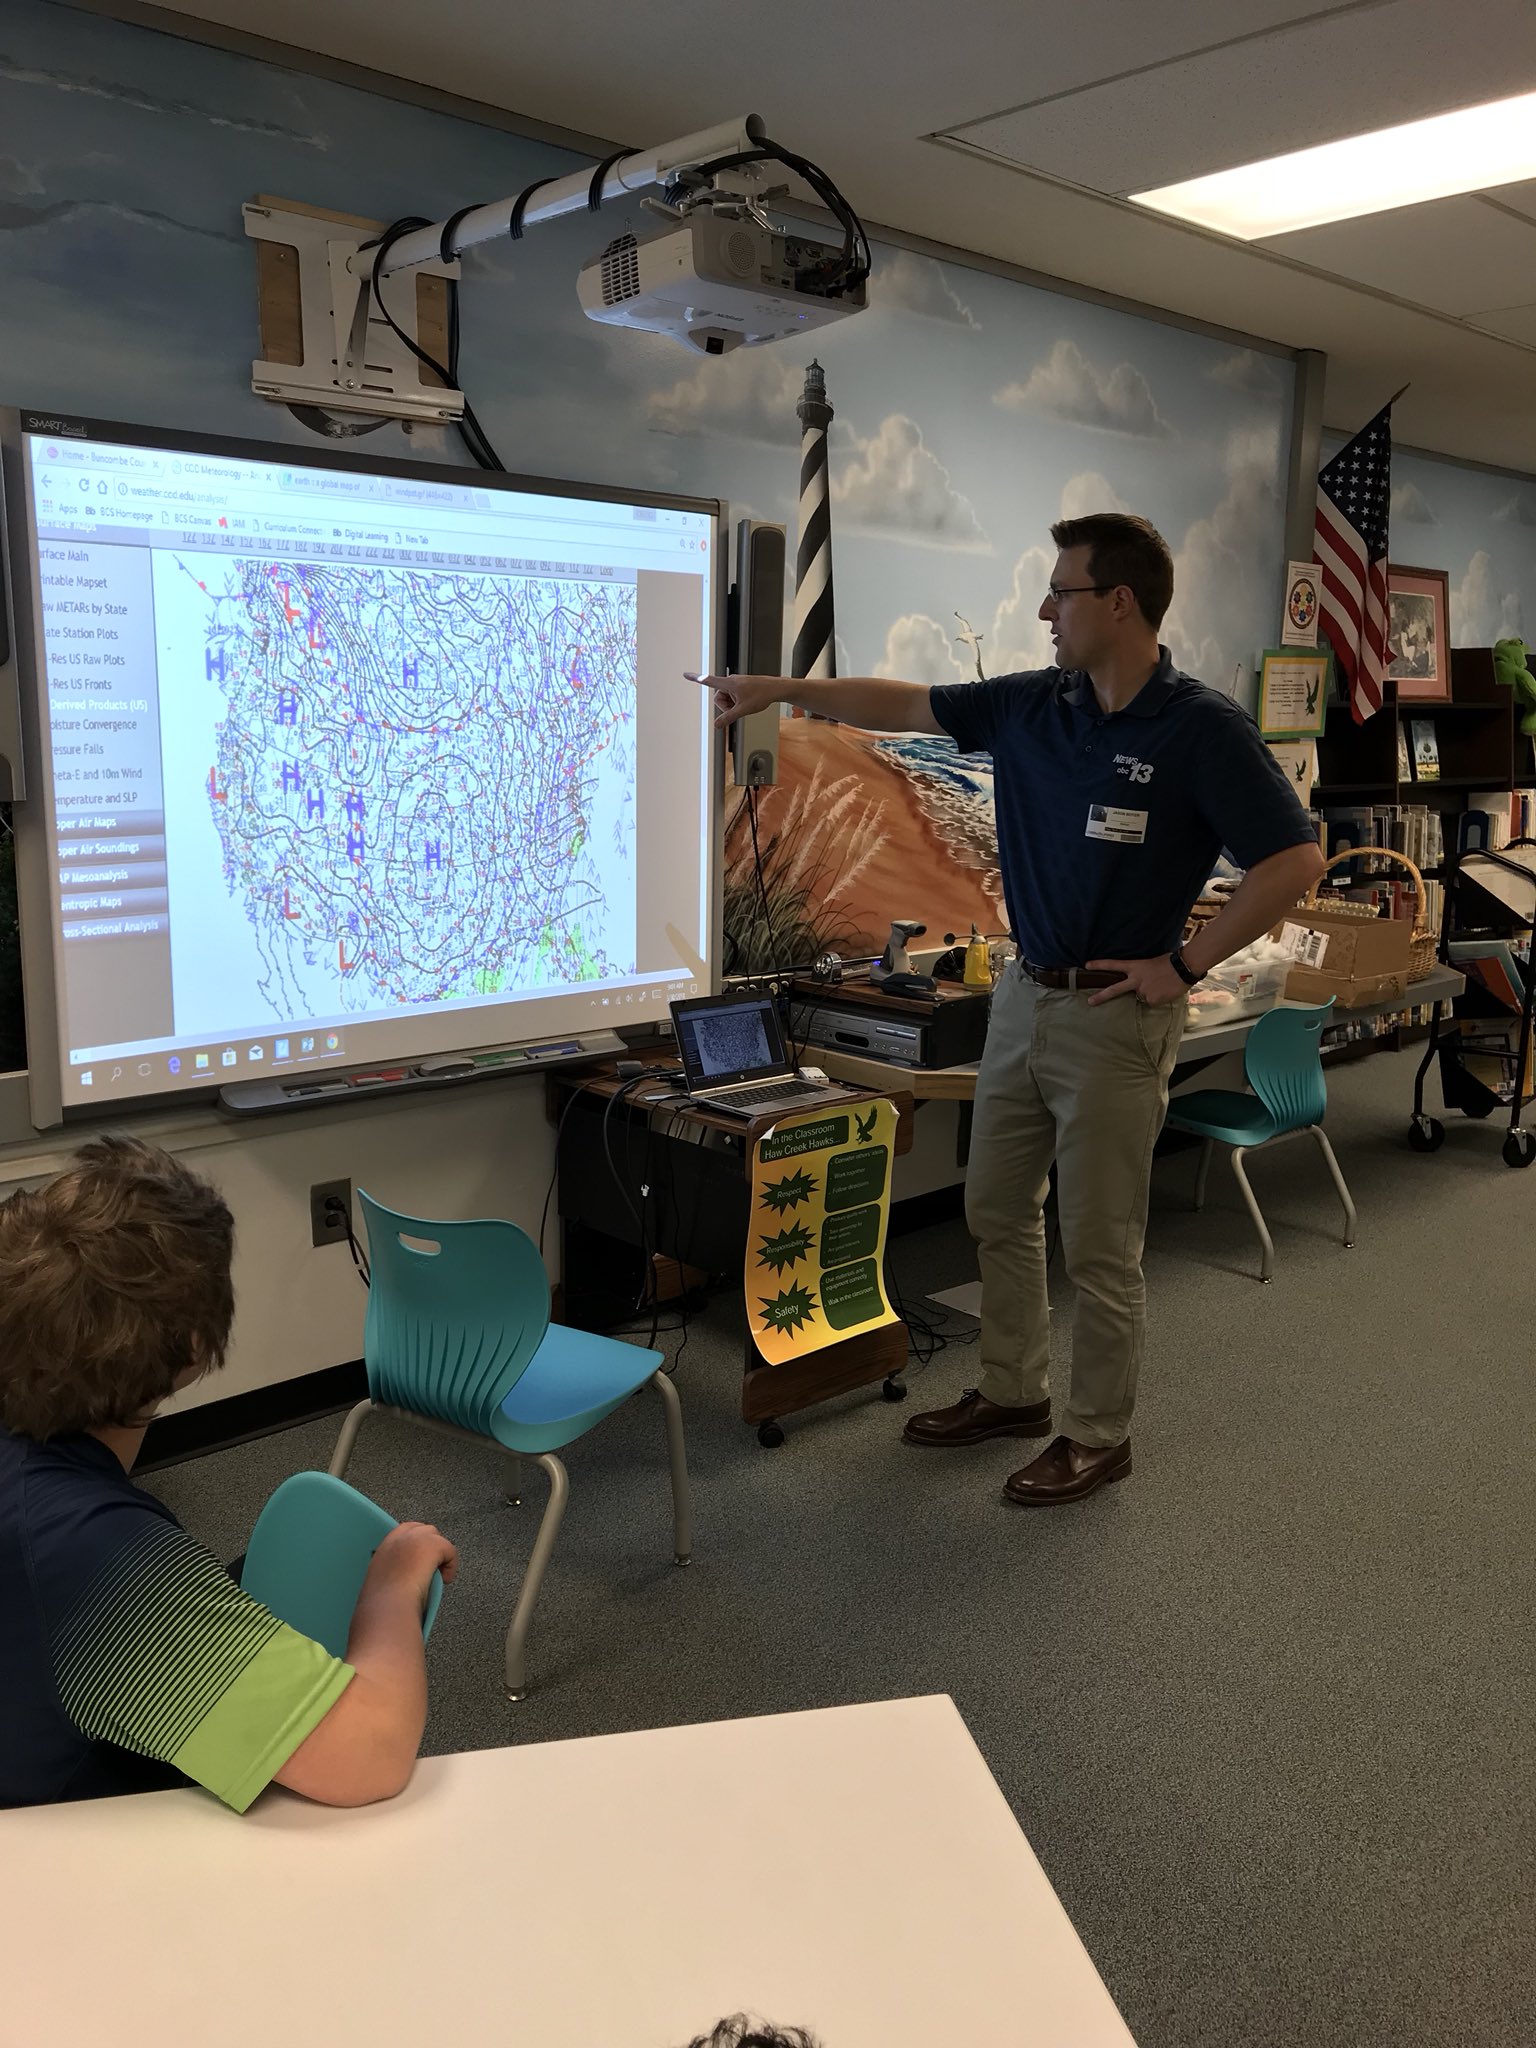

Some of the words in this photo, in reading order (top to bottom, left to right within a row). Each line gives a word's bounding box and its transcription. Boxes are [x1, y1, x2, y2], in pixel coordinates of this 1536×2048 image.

[29, 417, 62, 431] SMART
[62, 449, 84, 461] Home
[91, 451, 128, 466] Buncombe
[201, 465, 241, 480] Meteorology
[59, 503, 78, 515] Apps
[116, 508, 154, 522] Homepage
[345, 528, 363, 541] Digital
[365, 532, 389, 543] Learning
[405, 534, 418, 543] New
[419, 535, 429, 544] Tab
[67, 550, 89, 561] Main
[76, 576, 108, 590] Mapset
[56, 601, 90, 613] METARs
[91, 603, 102, 616] by
[105, 603, 128, 615] State
[63, 627, 95, 639] Station
[97, 628, 118, 640] Plots
[69, 653, 81, 665] US
[83, 653, 101, 665] Raw
[104, 654, 125, 666] Plots
[70, 678, 82, 690] US
[84, 679, 112, 690] Fronts
[50, 699, 86, 711] Derived
[88, 700, 127, 711] Products
[130, 700, 148, 713] (US)
[83, 719, 137, 732] Convergence
[83, 743, 104, 755] Falls
[1113, 753, 1139, 766] NEWS
[83, 769, 99, 780] and
[102, 768, 119, 780] 10m
[121, 768, 142, 779] Wind
[1117, 766, 1129, 775] abc
[1129, 763, 1154, 784] 13
[105, 792, 121, 804] and
[123, 792, 138, 803] SLP
[79, 818, 92, 828] Air
[94, 817, 117, 829] Maps
[80, 844, 94, 855] Air
[95, 842, 140, 855] Soundings
[72, 869, 128, 883] Mesoanalysis
[100, 897, 122, 909] Maps
[124, 920, 159, 933] Analysis
[772, 1136, 780, 1145] In
[781, 1132, 793, 1143] the
[794, 1123, 835, 1140] Classroom
[764, 1148, 783, 1160] Haw
[784, 1141, 807, 1155] Creek
[777, 1186, 802, 1199] Respect
[766, 1239, 805, 1254] Responsibility
[828, 1298, 840, 1306] Walk
[774, 1304, 799, 1319] Safety
